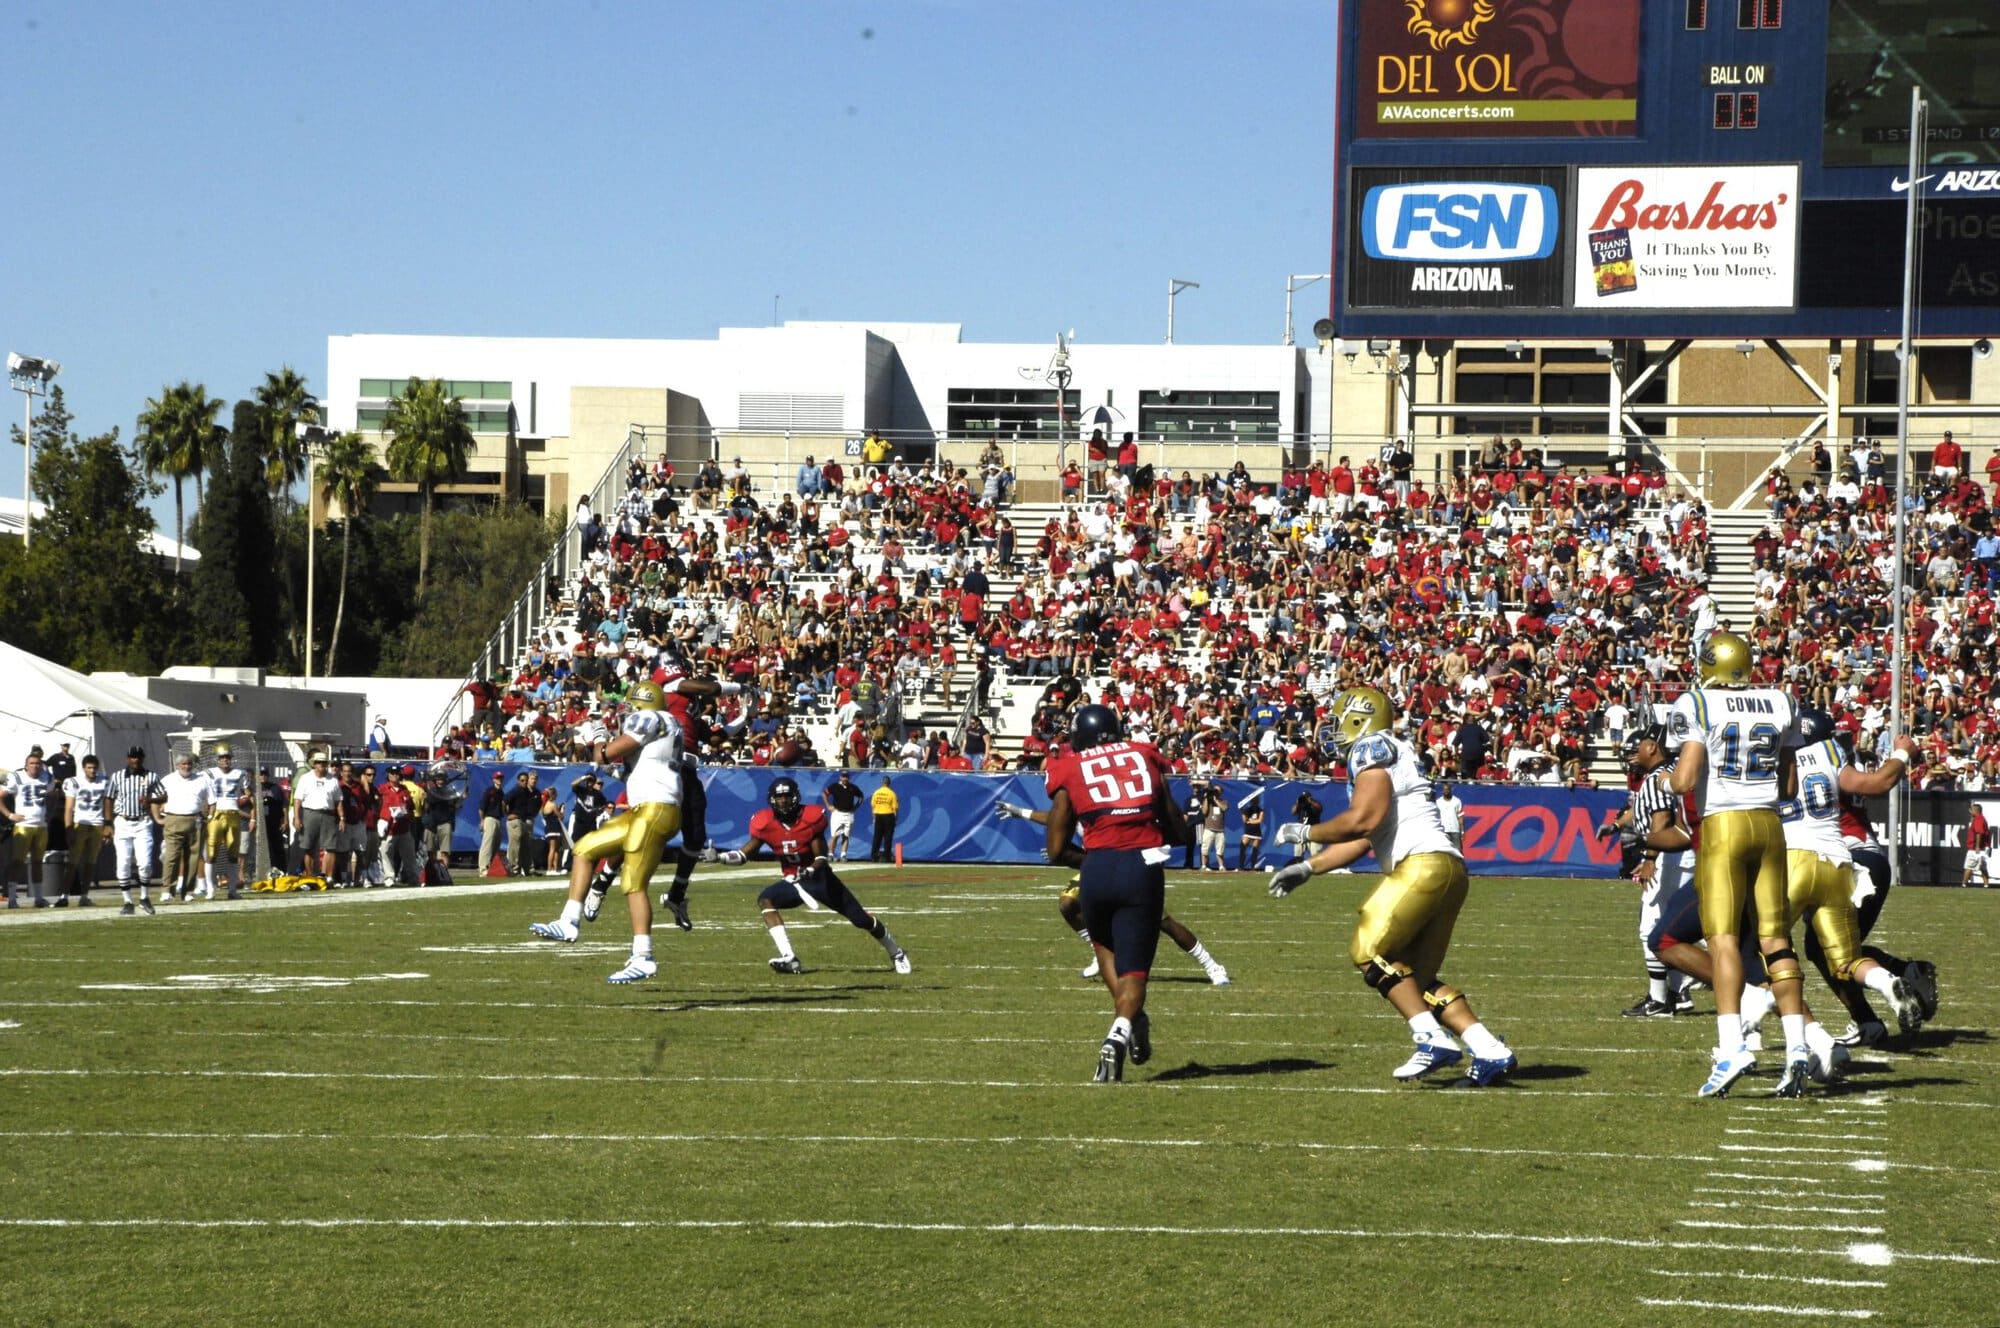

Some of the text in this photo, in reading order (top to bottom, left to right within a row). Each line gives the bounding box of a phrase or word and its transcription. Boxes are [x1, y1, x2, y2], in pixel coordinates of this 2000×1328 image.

[1378, 53, 1518, 94] DEL SOL
[1710, 65, 1764, 85] BALL ON
[1382, 104, 1514, 119] AVAconcerts.com
[1877, 128, 1911, 141] 1ST
[1588, 179, 1788, 231] Bashas'
[1392, 193, 1528, 249] FSN
[1592, 238, 1628, 252] THANK
[1646, 242, 1772, 259] It Thanks You By
[1600, 248, 1626, 262] YOU
[1411, 267, 1503, 291] ARIZONA
[1639, 263, 1777, 280] Saving You Money.
[847, 439, 860, 455] 26
[1382, 447, 1395, 462] 27
[905, 678, 924, 690] 26
[1726, 697, 1774, 715] COWAN
[1718, 721, 1781, 780] 12
[1080, 751, 1152, 803] 53
[1906, 822, 1961, 848] MILK
